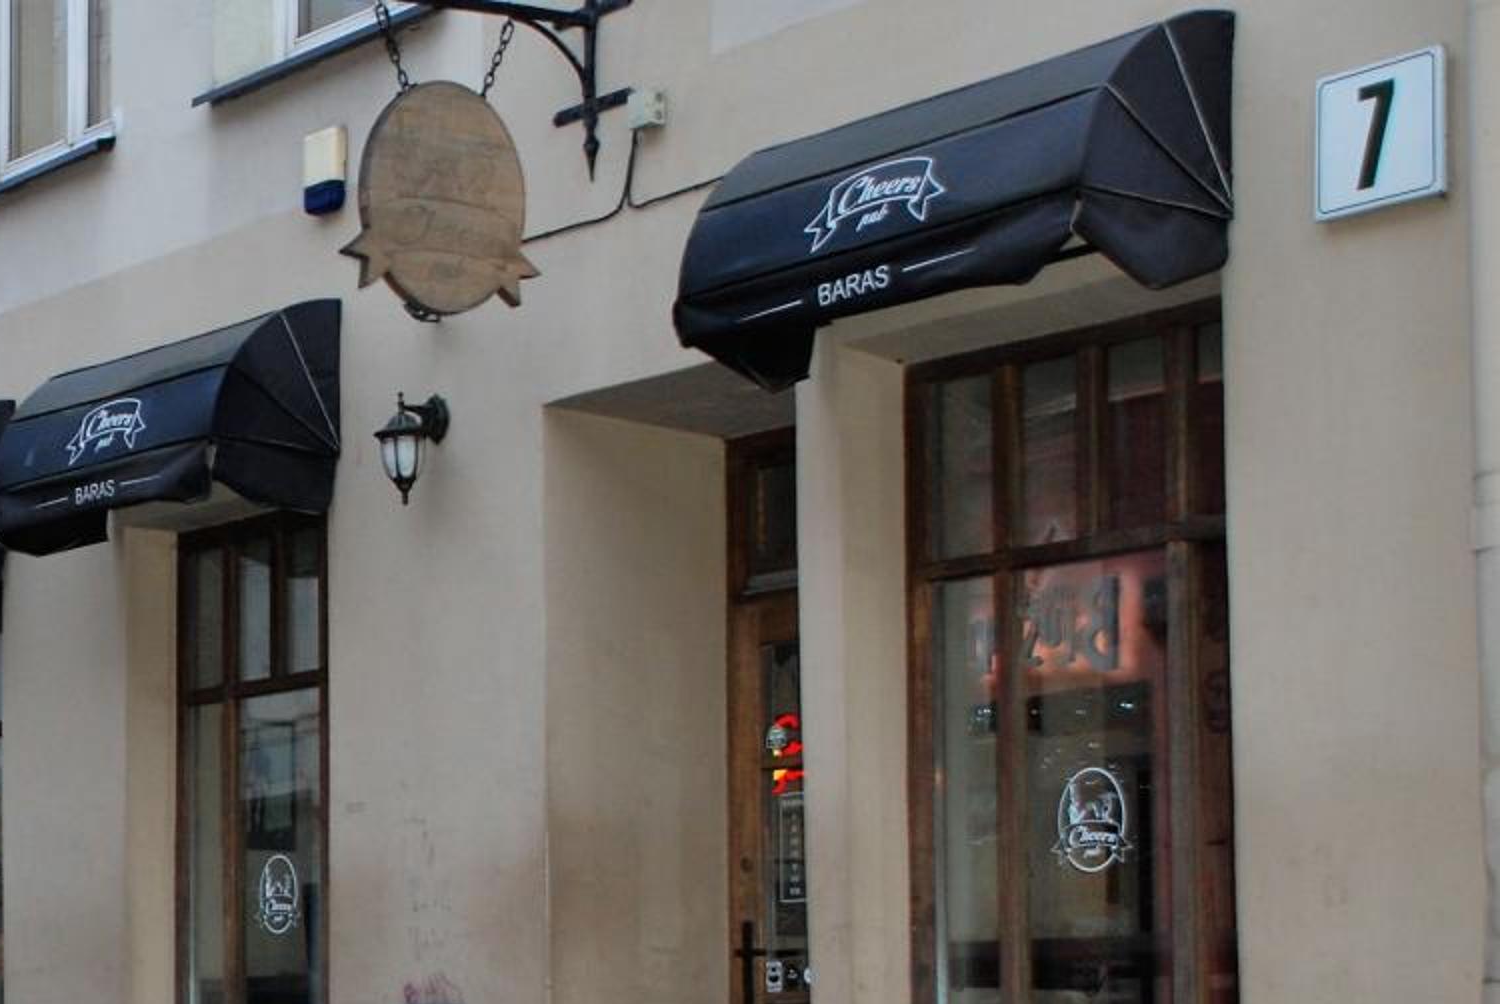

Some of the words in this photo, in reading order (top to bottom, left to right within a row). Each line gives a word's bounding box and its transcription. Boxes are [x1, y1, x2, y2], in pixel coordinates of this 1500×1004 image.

[1357, 78, 1395, 190] 7
[837, 175, 922, 215] Cheers
[817, 265, 890, 307] BARAS
[75, 479, 116, 505] BARAS
